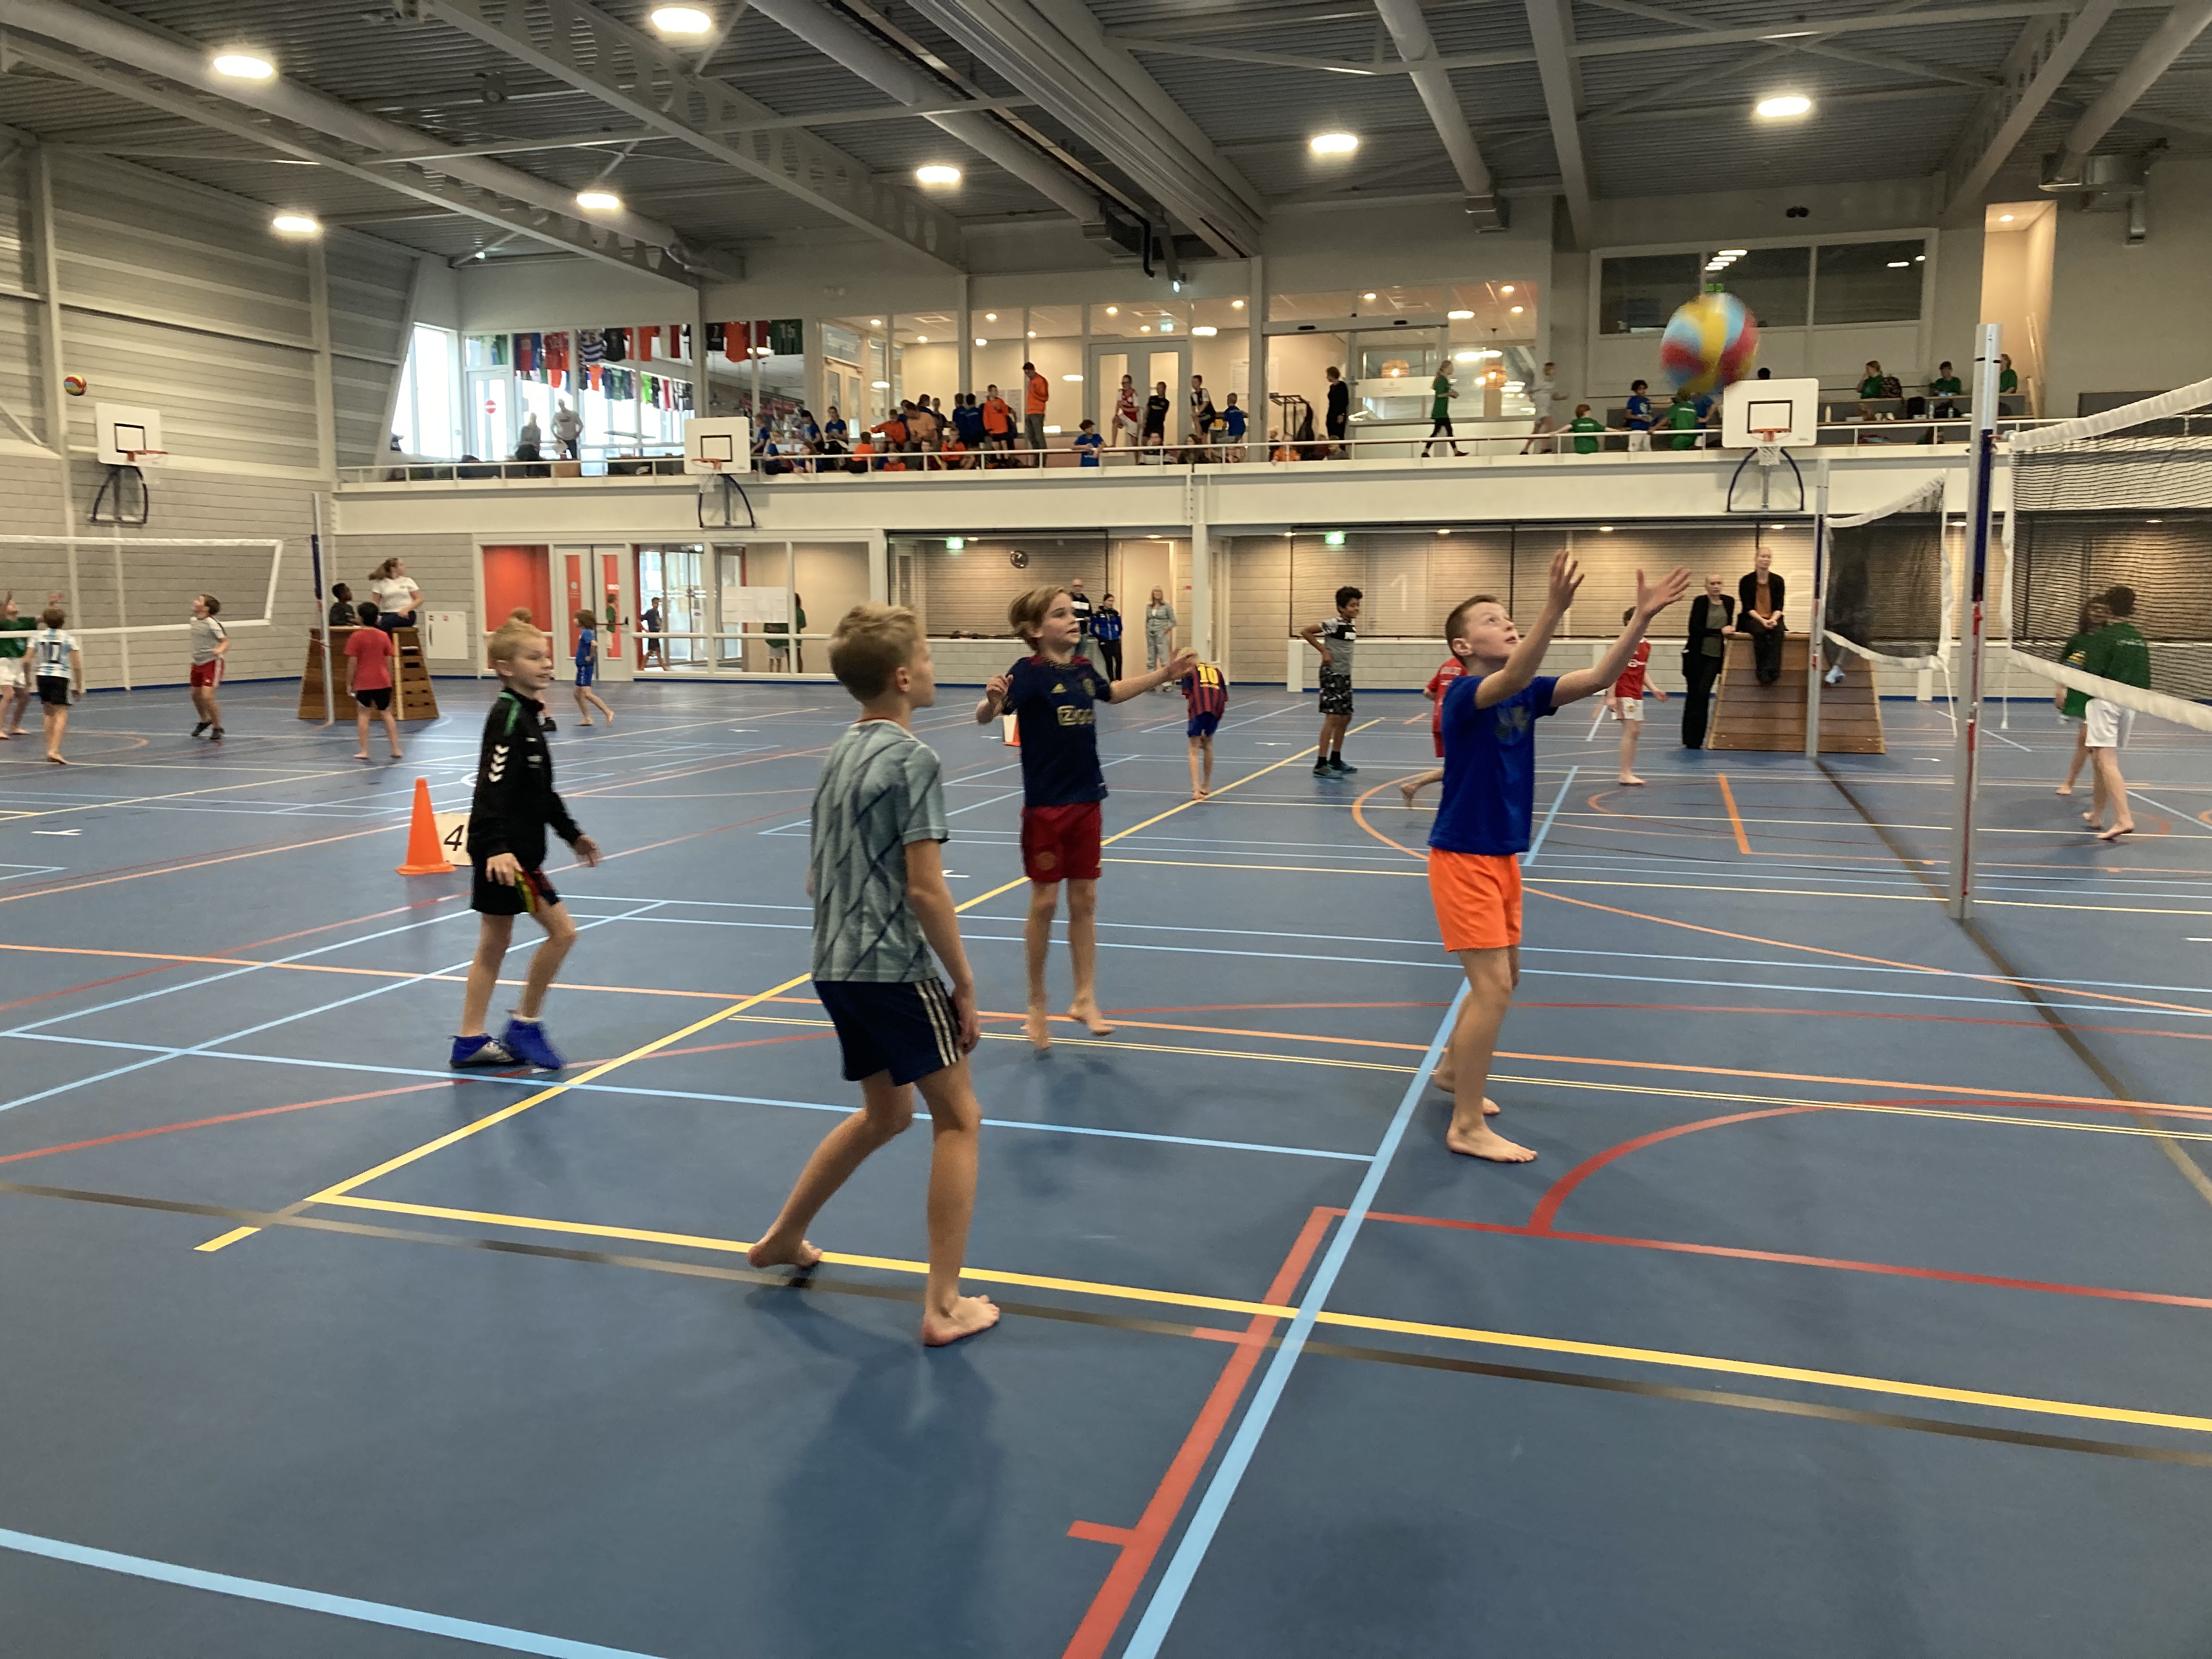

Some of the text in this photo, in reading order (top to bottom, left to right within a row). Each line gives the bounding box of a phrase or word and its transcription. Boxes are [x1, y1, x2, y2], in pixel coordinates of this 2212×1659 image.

[1390, 574, 1407, 611] 1
[1198, 665, 1218, 684] 10
[444, 825, 465, 851] 4
